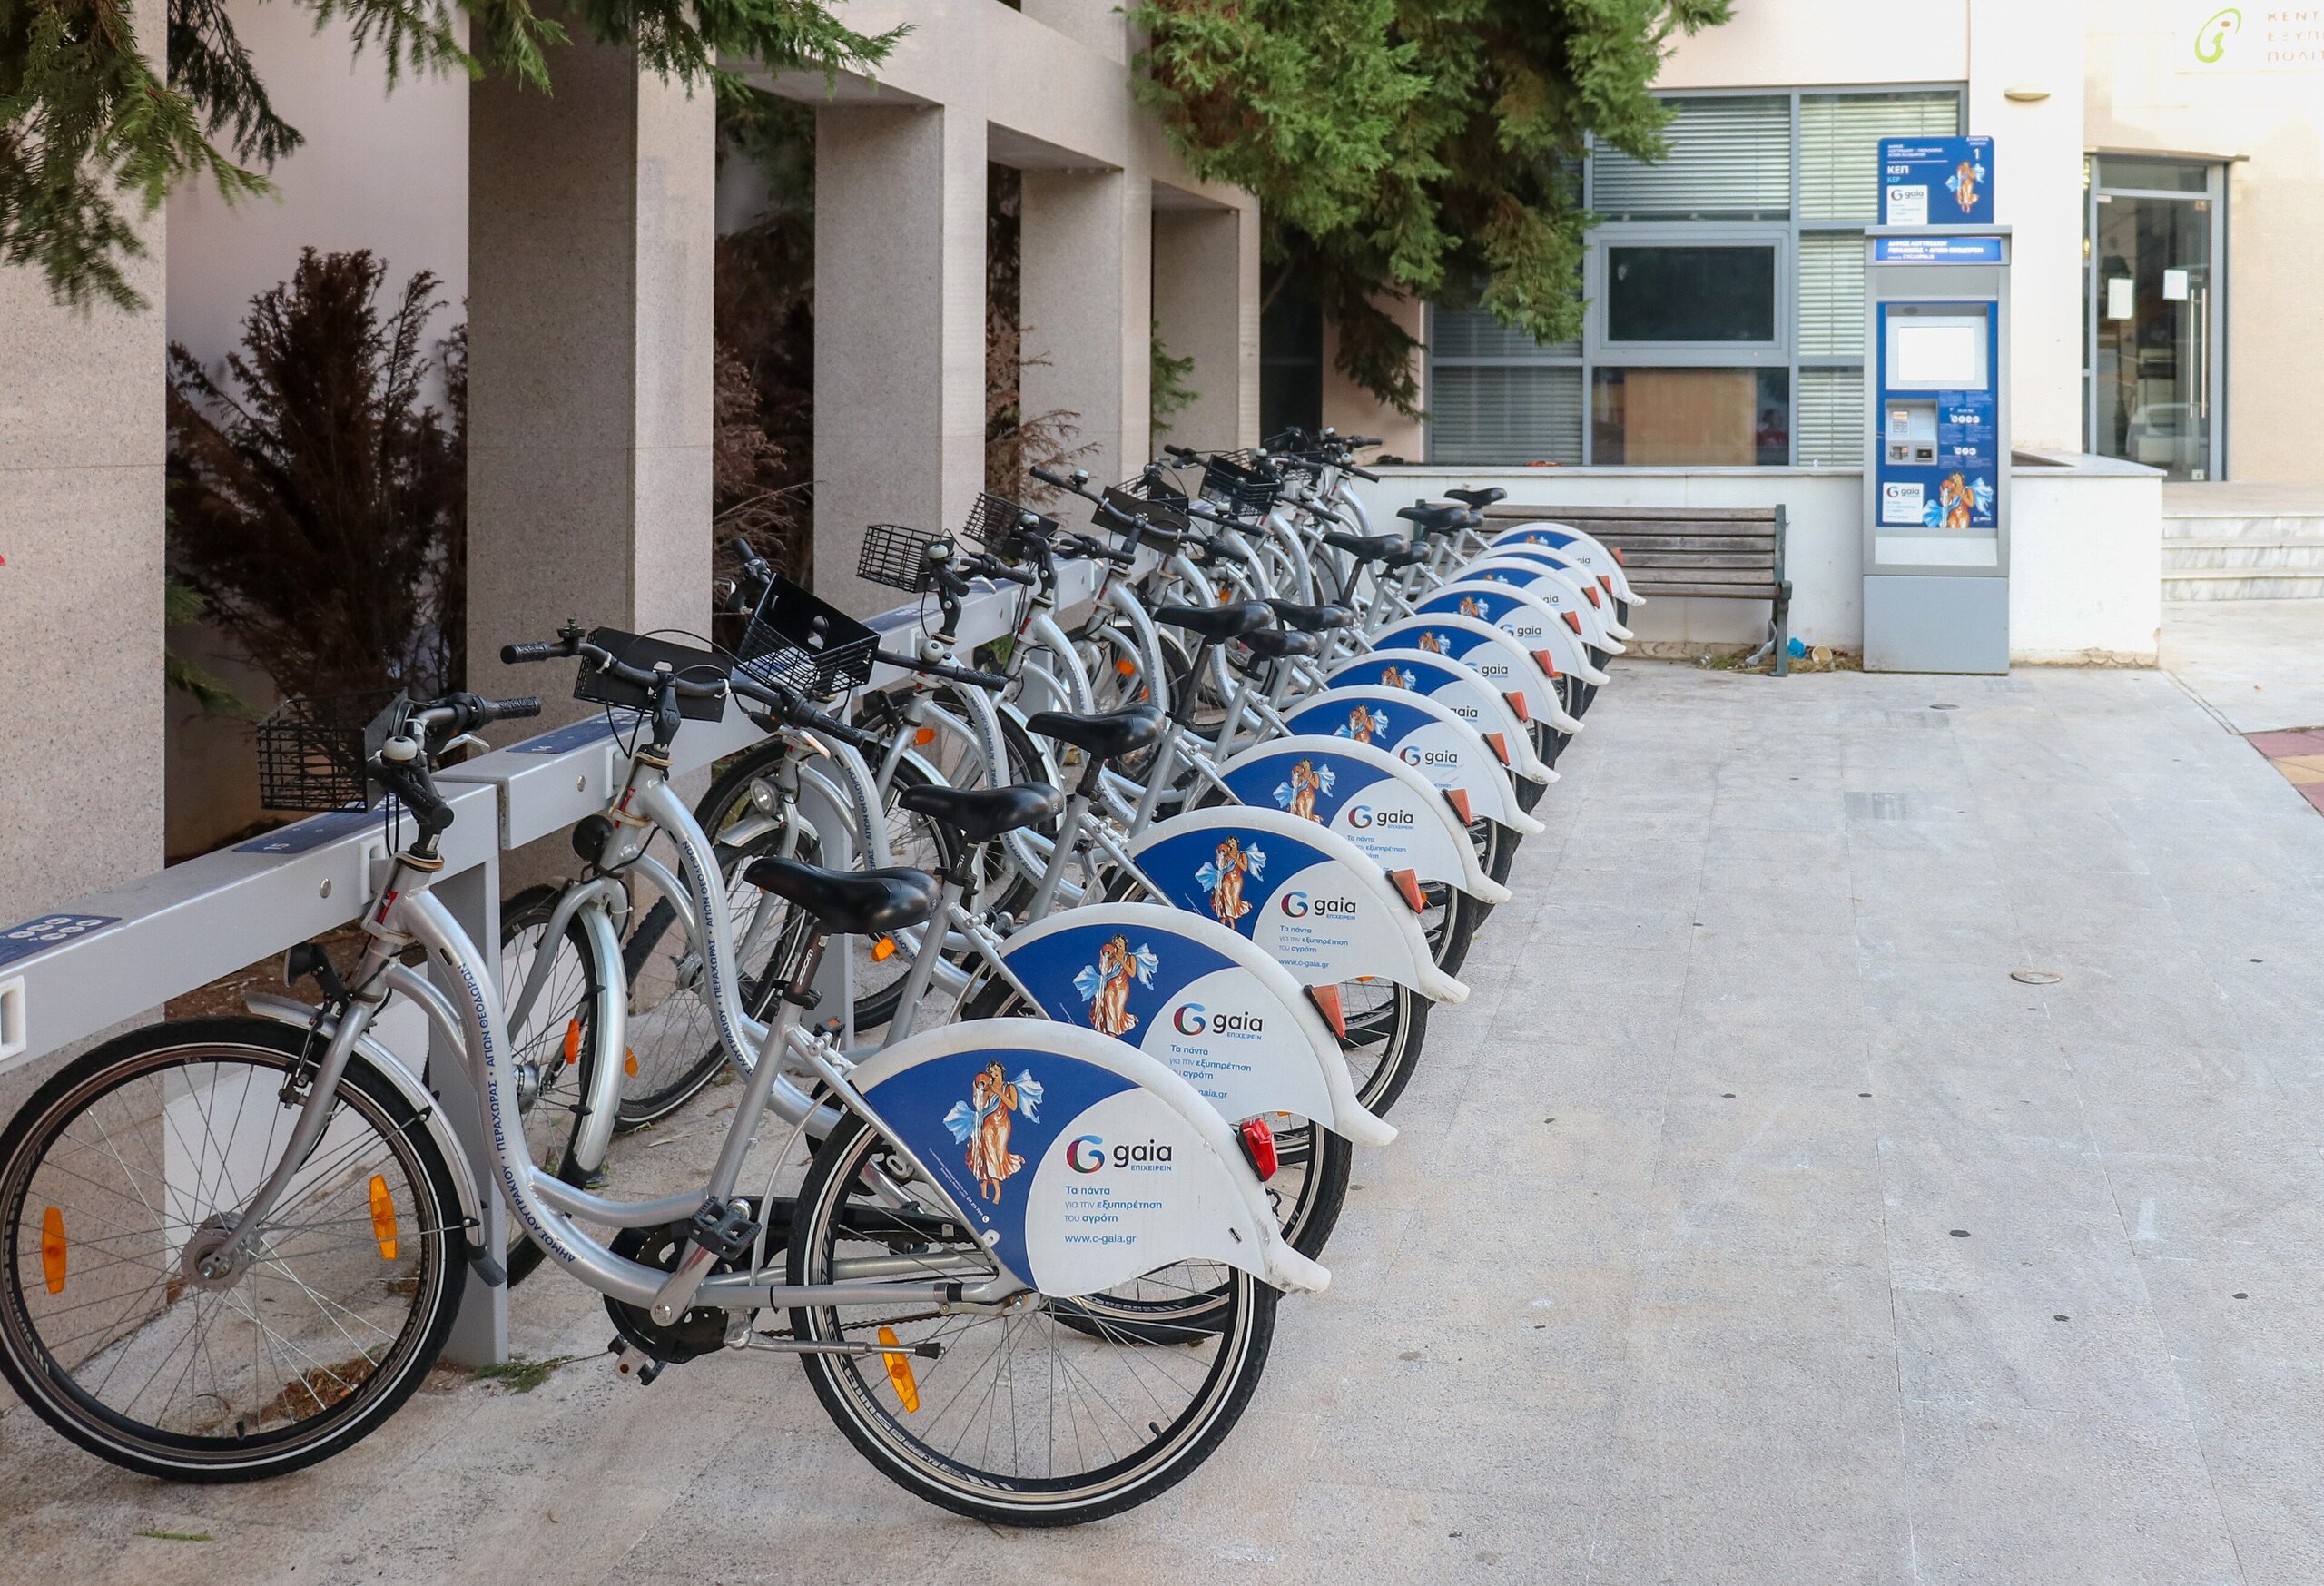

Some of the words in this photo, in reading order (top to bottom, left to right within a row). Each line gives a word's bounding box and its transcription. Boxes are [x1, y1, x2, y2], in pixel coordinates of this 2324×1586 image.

[2268, 31, 2324, 42] ΕΞΥΠ
[1973, 147, 1980, 160] 1
[1886, 165, 1909, 174] ΚΕΠ
[1905, 189, 1924, 199] gaia
[1901, 487, 1920, 497] gaia
[1517, 626, 1541, 637] gaia
[1482, 664, 1508, 677] gaia
[1424, 750, 1458, 765] gaia
[1376, 809, 1413, 825] gaia
[682, 842, 709, 895] ΘΕΟΔΩΡΩΝ
[703, 896, 714, 928] ΑΓΙΩΝ
[1314, 897, 1356, 917] gaia
[707, 937, 722, 998] ΠΕΡΑΧΩΡΑΣ
[458, 963, 487, 1029] ΘΕΟΔΩΡΩΝ
[1212, 1011, 1264, 1034] gaia
[718, 1009, 747, 1069] ΛΟΥΤΡΑΚΙΟΥ
[1226, 1032, 1262, 1040] ΕΠΙΧΕΙΡΕΙΝ
[482, 1029, 496, 1068] ΑΓΙΩΝ
[1170, 1045, 1181, 1053] Τα
[1183, 1046, 1208, 1056] πάντα
[1196, 1059, 1252, 1072] εξυπηρέτηση
[1182, 1070, 1214, 1080] αγρότη
[489, 1079, 507, 1151] ΠΕΡΑΧΩΡΑΣ
[1112, 1138, 1173, 1168] gaia
[1130, 1164, 1172, 1172] ΕΠΙΧΕΙΡΕΙΝ
[1065, 1186, 1078, 1195] Τα
[1080, 1186, 1110, 1196] πάντα
[502, 1164, 539, 1232] ΛΟΥΤΡΑΚΙΟΥ
[1097, 1200, 1163, 1211] εξυπηρέτηση
[1082, 1213, 1118, 1225] αγρότη
[1065, 1234, 1137, 1245] www.c-gaia.gr
[537, 1229, 576, 1264] ΔΗΜΟΣ
